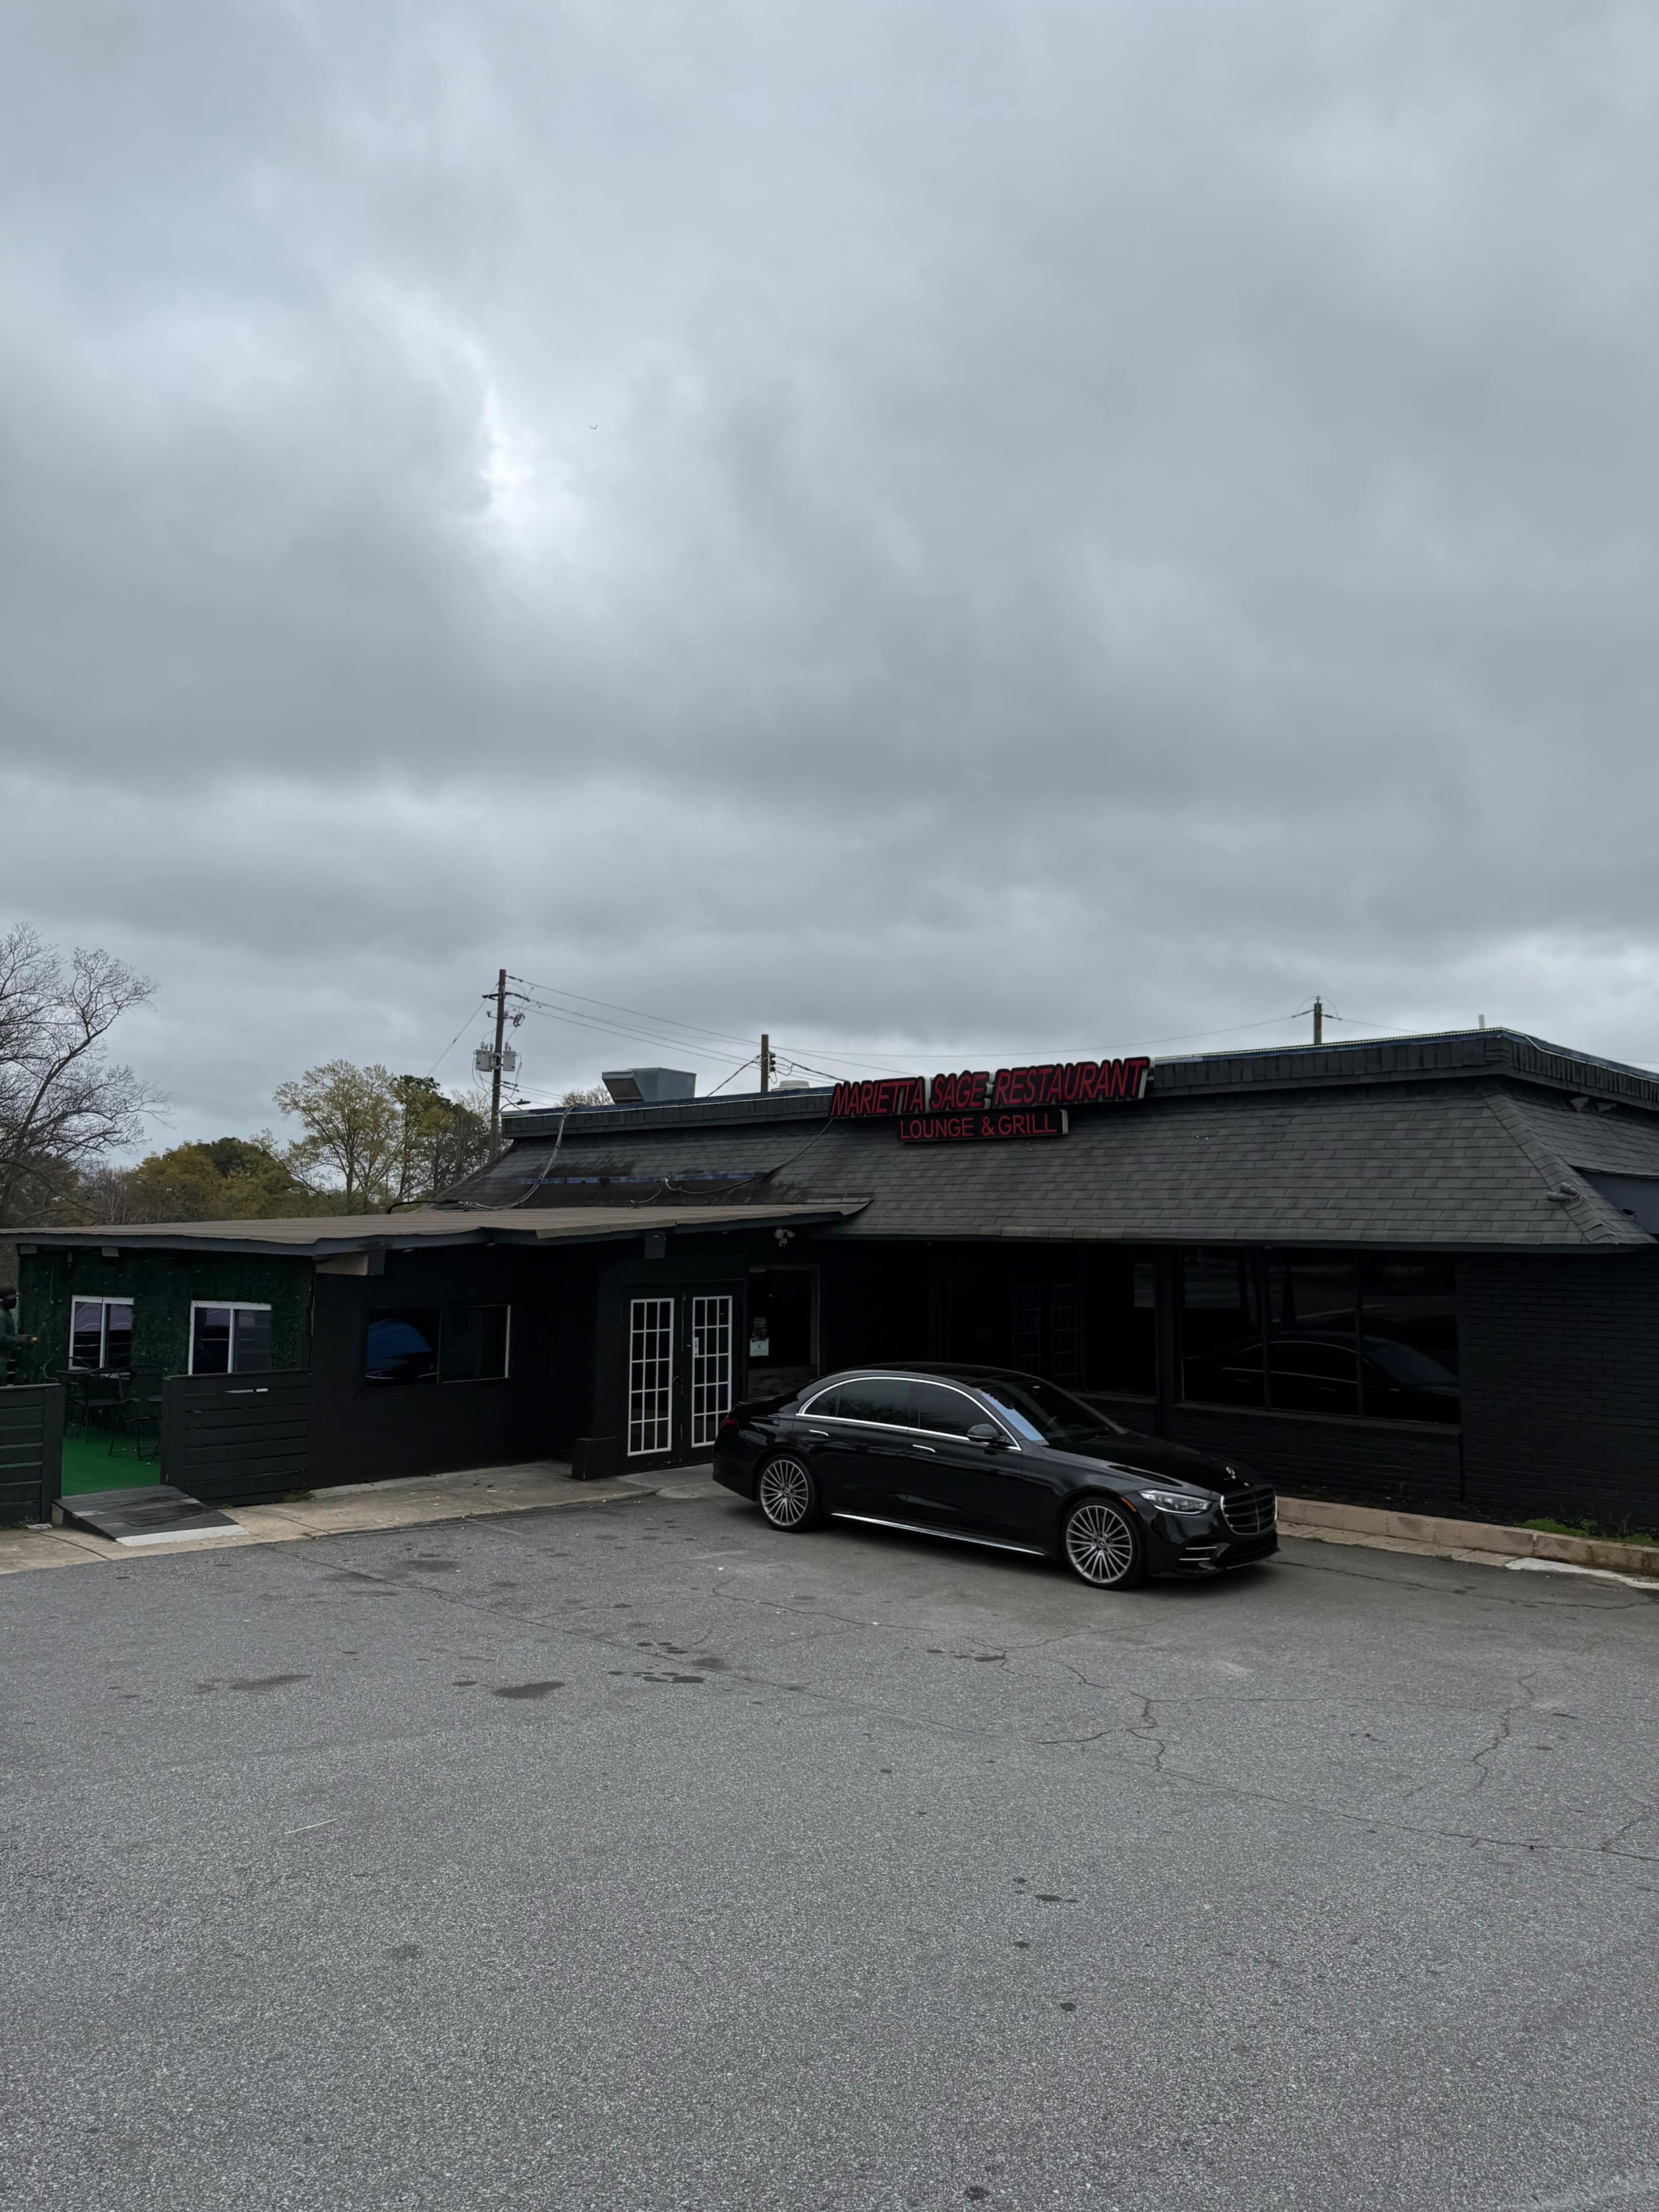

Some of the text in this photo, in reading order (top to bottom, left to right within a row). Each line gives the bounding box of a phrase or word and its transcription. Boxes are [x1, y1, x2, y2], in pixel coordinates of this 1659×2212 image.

[830, 1059, 1147, 1117] MARIETTA SAGE RESTAURANT
[899, 1117, 974, 1140] LOUNGE
[998, 1113, 1058, 1135] GRILL
